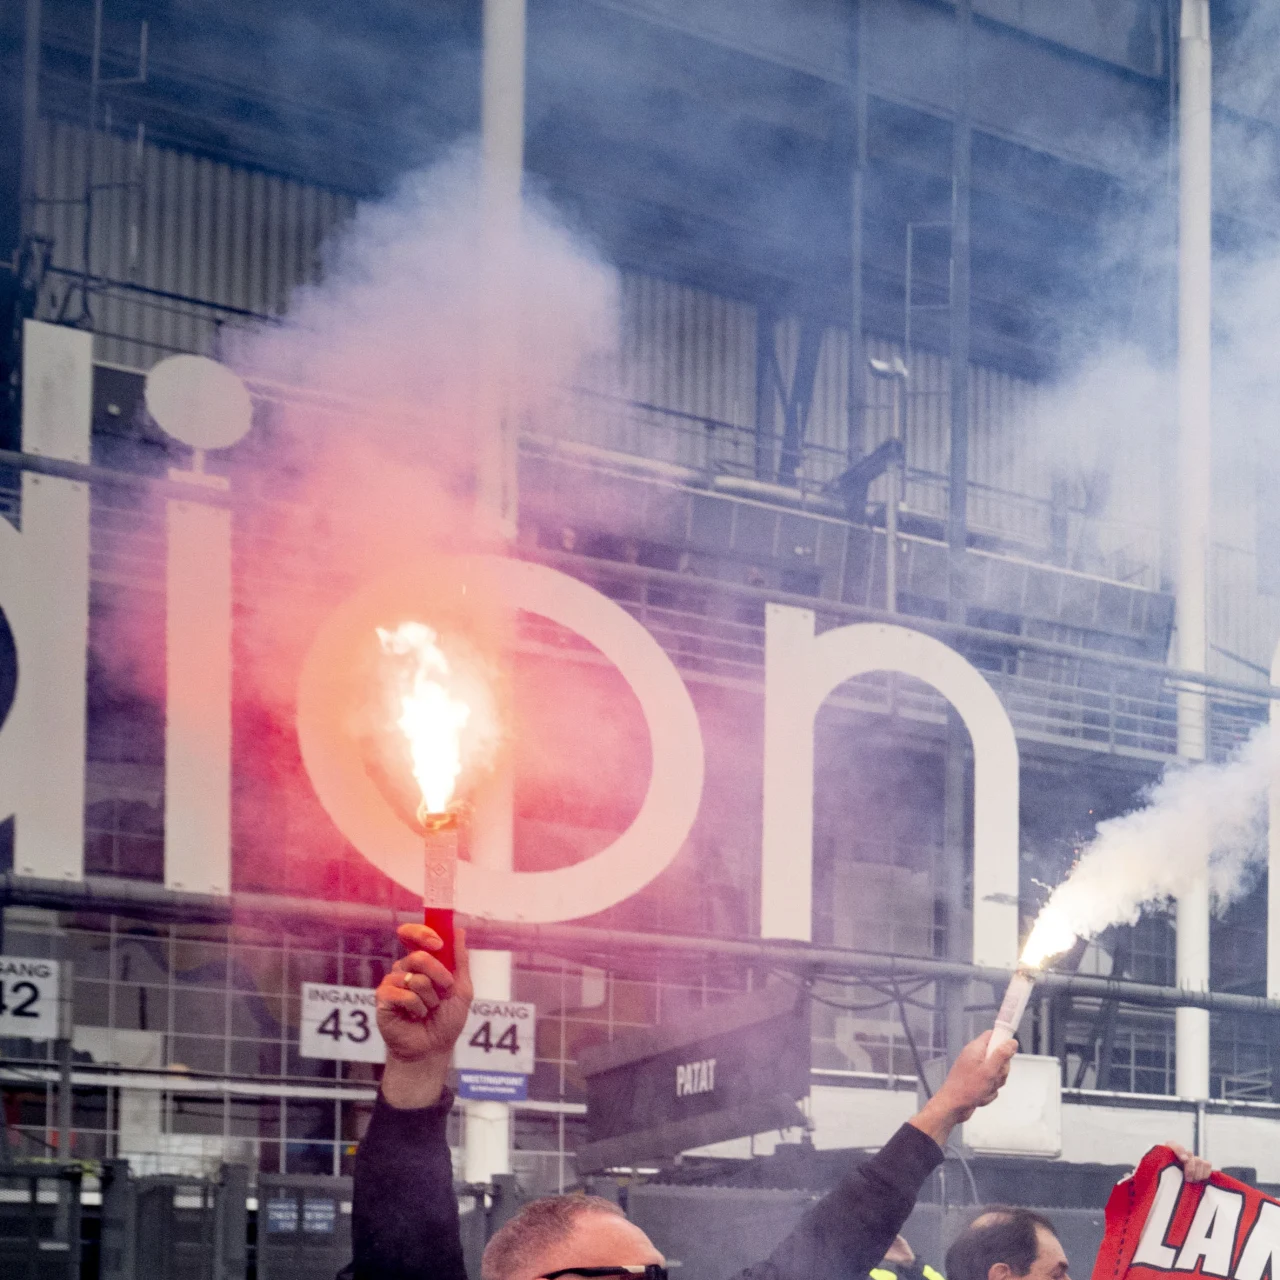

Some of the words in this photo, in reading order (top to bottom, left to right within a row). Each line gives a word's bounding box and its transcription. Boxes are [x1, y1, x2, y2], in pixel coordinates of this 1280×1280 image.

[0, 963, 51, 978] ANG
[0, 981, 39, 1018] 2
[471, 1003, 529, 1019] NGANG
[316, 1008, 371, 1043] 43
[469, 1021, 520, 1055] 44
[676, 1058, 717, 1097] PATAT
